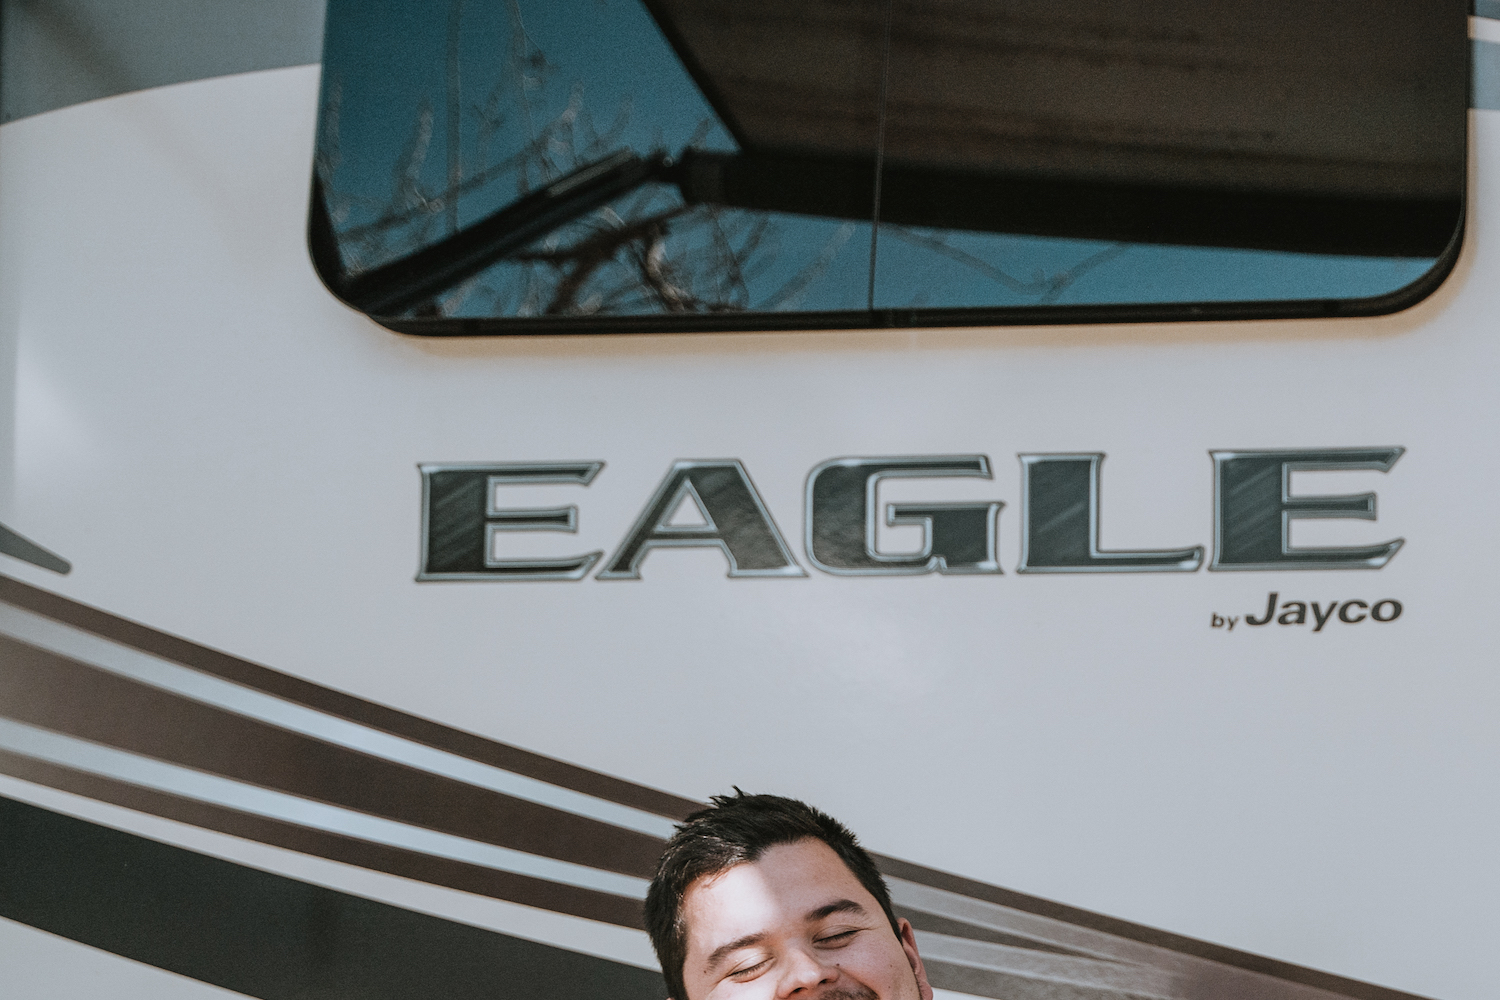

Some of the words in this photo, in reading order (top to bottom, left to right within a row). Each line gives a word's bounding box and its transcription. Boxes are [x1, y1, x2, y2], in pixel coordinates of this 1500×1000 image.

[414, 446, 1405, 583] EAGLE
[1211, 613, 1239, 632] by
[1245, 592, 1403, 632] Jayco
